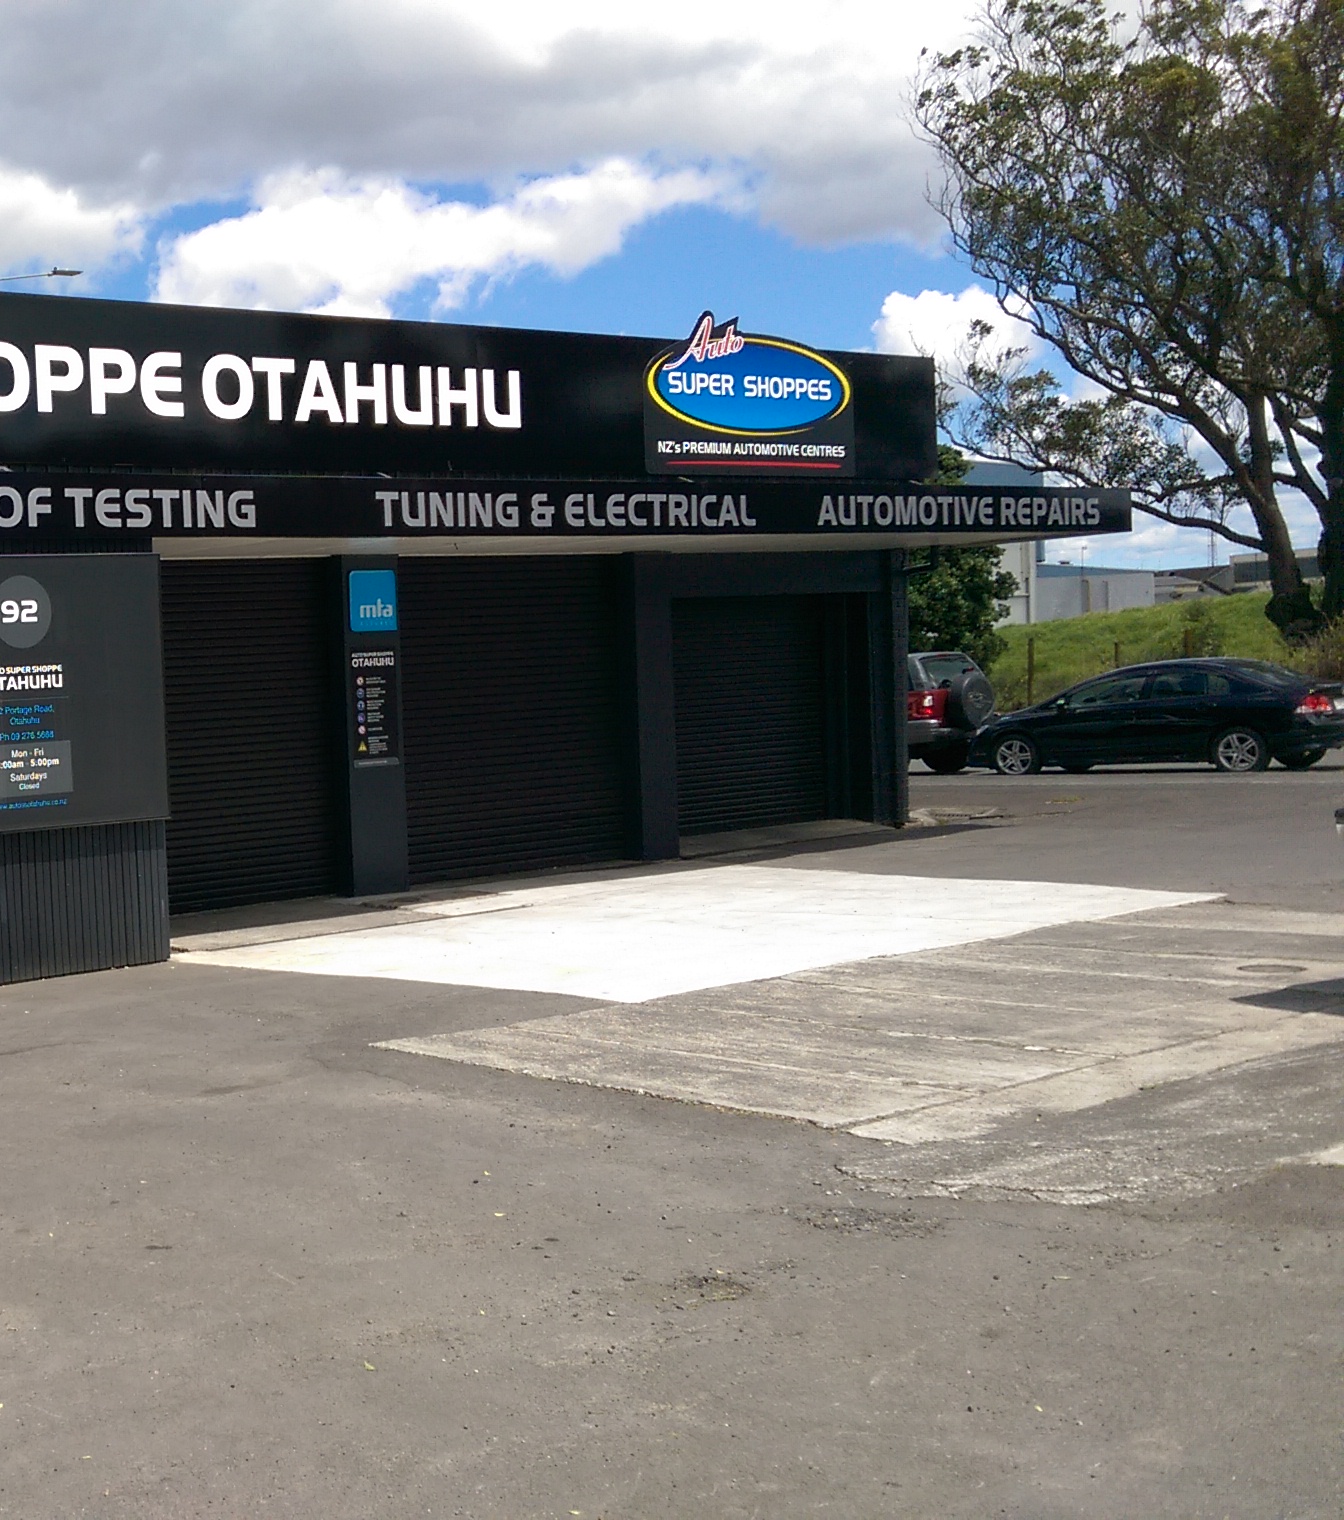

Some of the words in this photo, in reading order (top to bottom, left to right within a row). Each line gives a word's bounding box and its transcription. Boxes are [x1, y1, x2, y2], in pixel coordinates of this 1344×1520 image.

[661, 315, 744, 371] Auto
[201, 353, 522, 429] OTAHUHU
[668, 371, 735, 397] SUPER
[743, 375, 832, 401] SHOPPES
[657, 440, 681, 454] NZ's
[682, 441, 732, 456] PREMIUM
[733, 443, 800, 457] AUTOMOTIVE
[800, 445, 846, 459] CENTRES
[64, 487, 256, 528] TESTING
[376, 491, 519, 528] TUNING
[530, 493, 555, 527] &
[564, 493, 756, 527] ELECTRICAL
[817, 495, 993, 526] AUTOMOTIVE
[1000, 497, 1100, 525] REPAIRS
[0, 599, 38, 624] 92
[359, 598, 394, 619] mta
[6, 665, 31, 675] SUPER
[31, 664, 63, 673] SHOPPE
[351, 657, 395, 668] OTAHUHU
[4, 705, 32, 716] Portage
[11, 749, 28, 758] Mon
[33, 747, 45, 757] Fri
[10, 772, 48, 782] Saturdays
[18, 782, 40, 790] Closed
